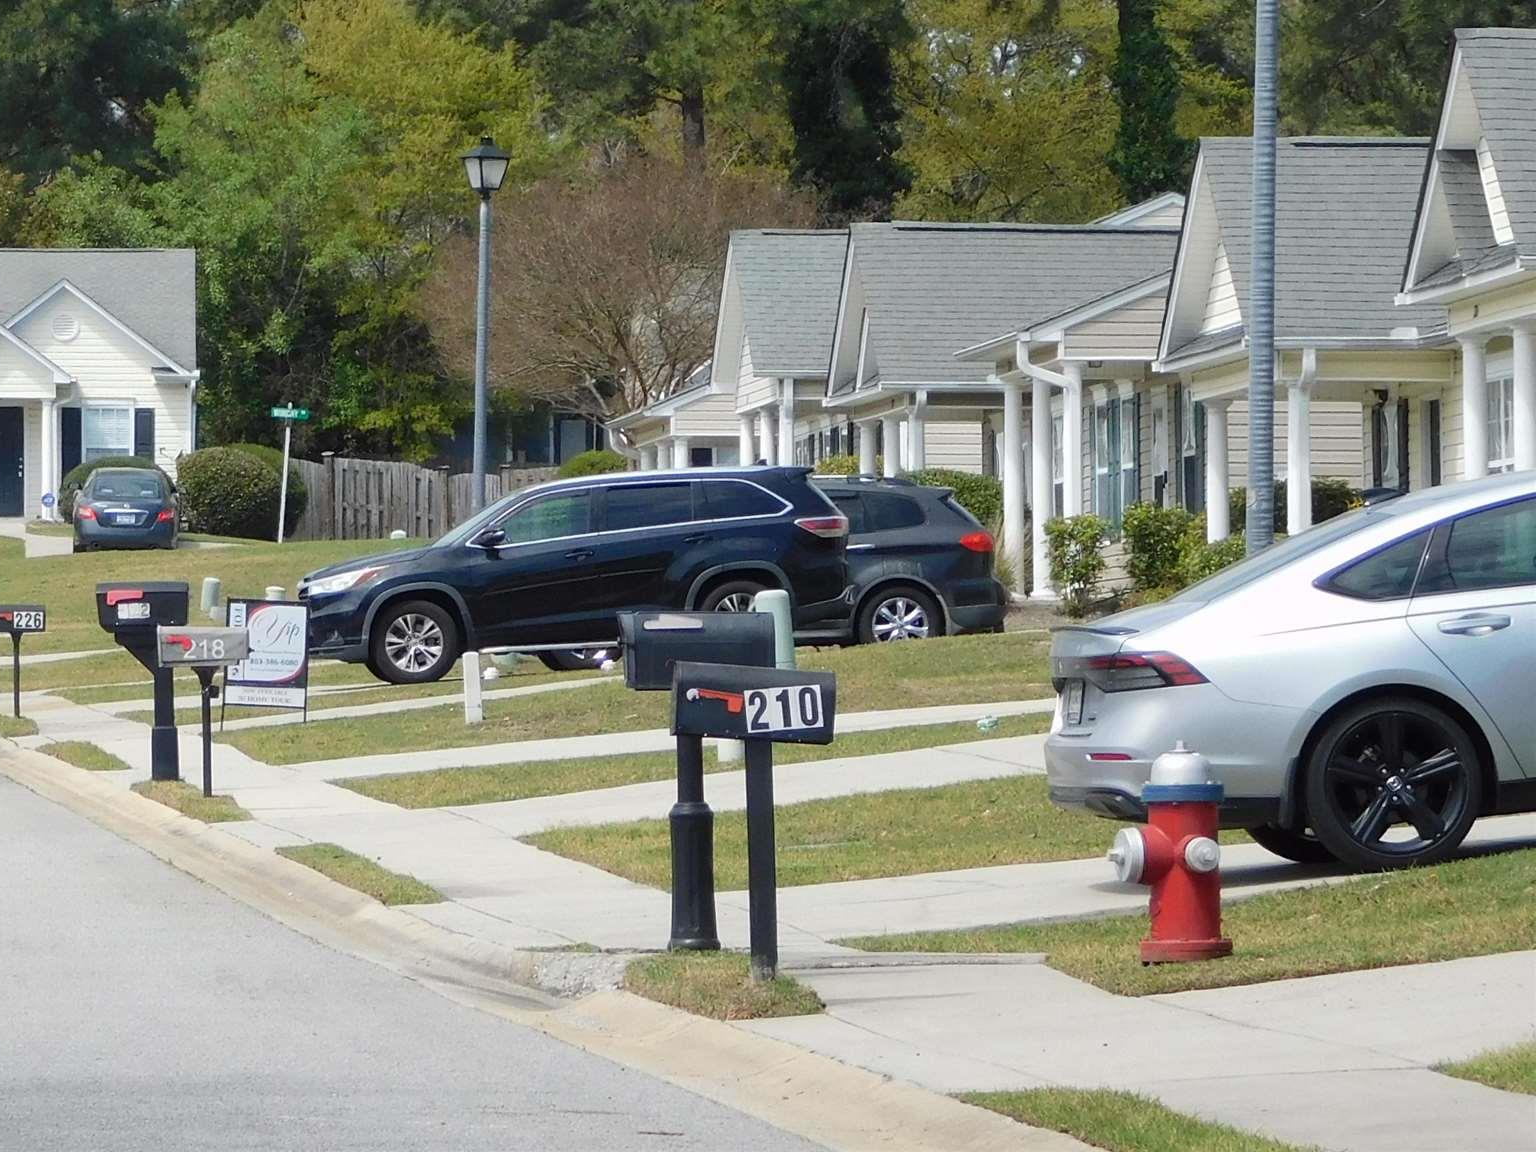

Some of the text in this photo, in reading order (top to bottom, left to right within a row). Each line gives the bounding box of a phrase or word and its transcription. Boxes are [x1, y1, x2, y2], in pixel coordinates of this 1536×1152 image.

[15, 612, 42, 628] 226
[184, 639, 224, 659] 218
[748, 687, 819, 730] 210
